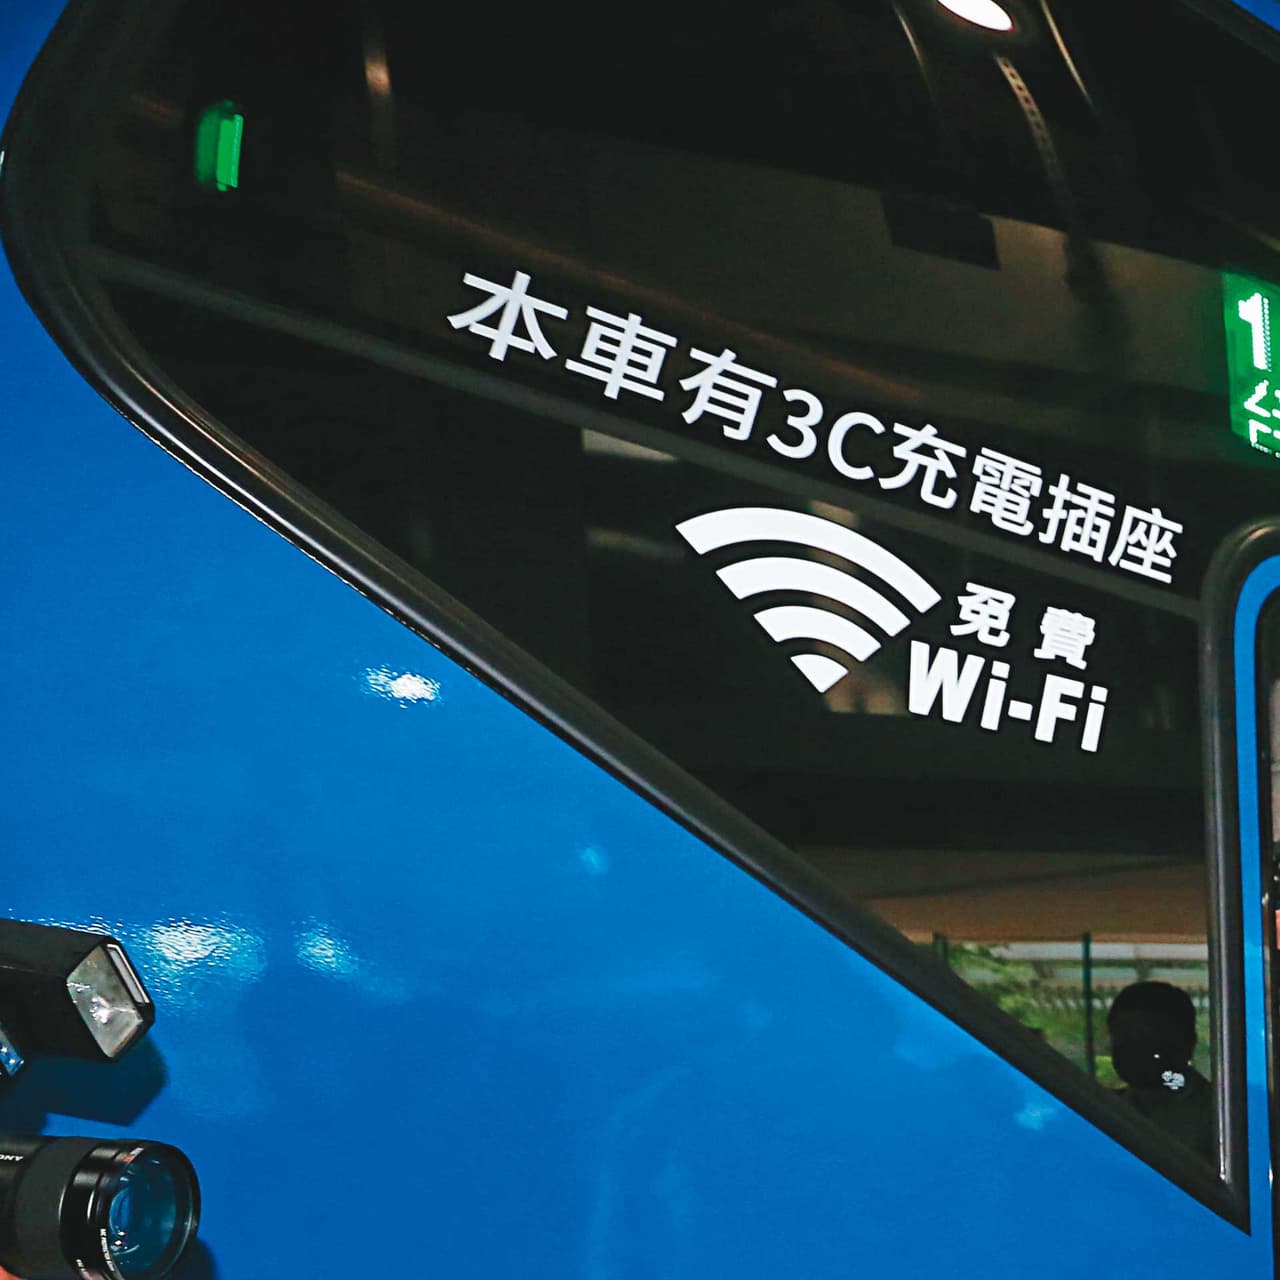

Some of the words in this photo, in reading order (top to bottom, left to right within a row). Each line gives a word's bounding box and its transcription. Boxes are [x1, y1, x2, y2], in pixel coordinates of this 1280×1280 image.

[447, 270, 1184, 585] 本車有3C充電插座
[951, 582, 1096, 670] 免費
[908, 640, 1107, 753] Wi-Fi
